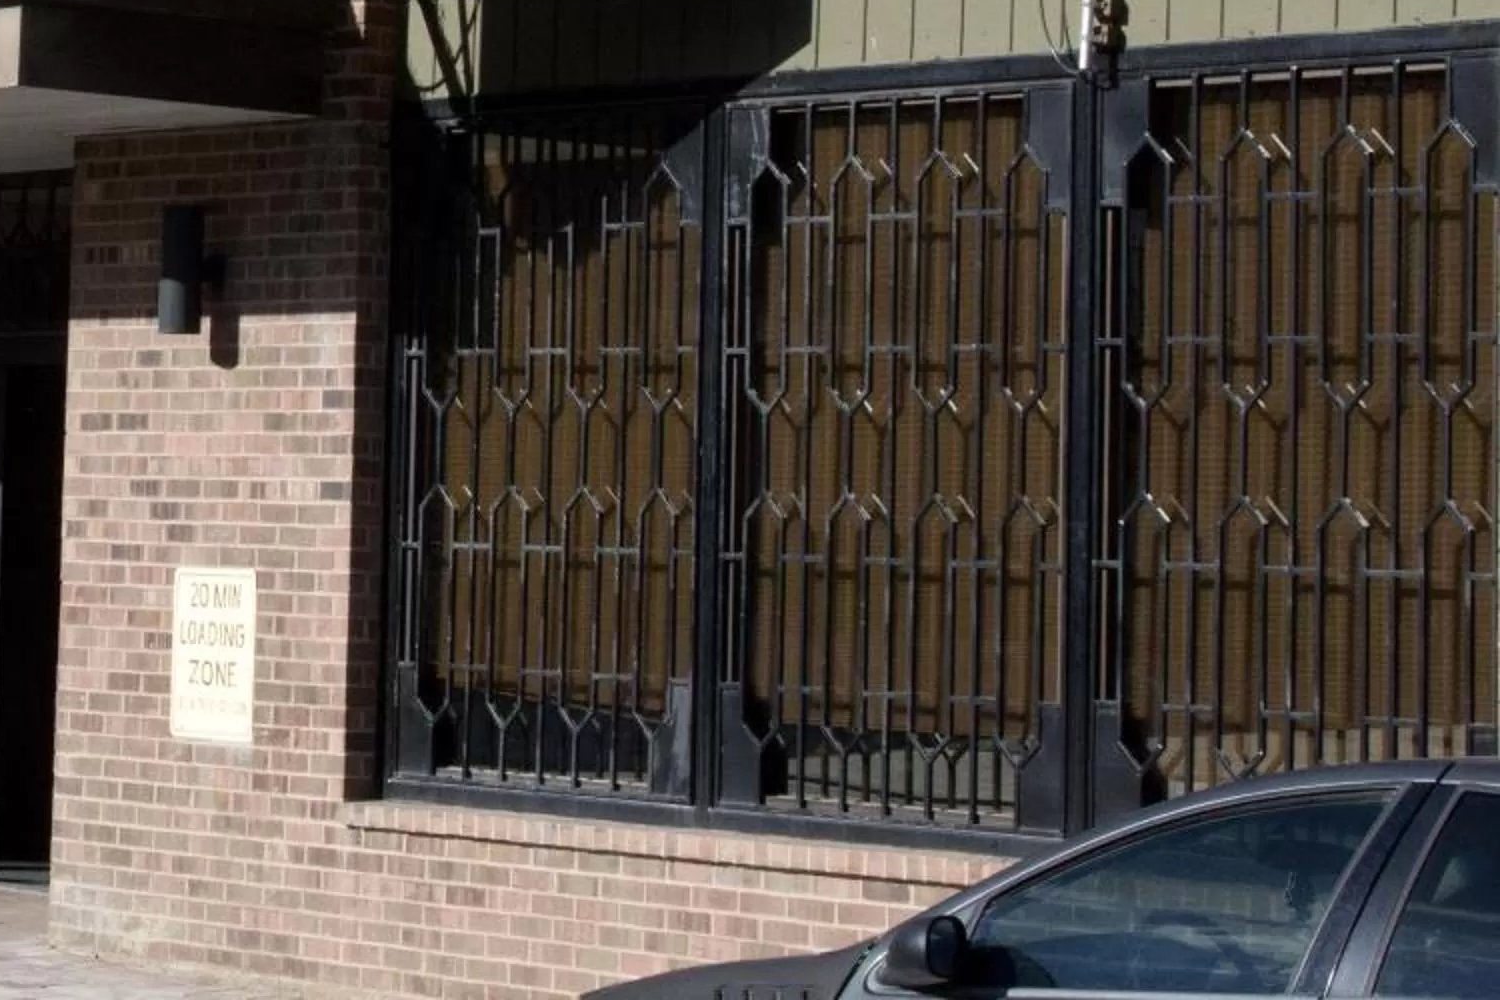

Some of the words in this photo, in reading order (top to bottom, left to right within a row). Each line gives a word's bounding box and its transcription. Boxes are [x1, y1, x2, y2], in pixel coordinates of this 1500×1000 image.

[190, 581, 210, 609] 20
[213, 583, 243, 609] MIN
[180, 620, 245, 649] LOADING
[188, 659, 238, 688] ZONE
